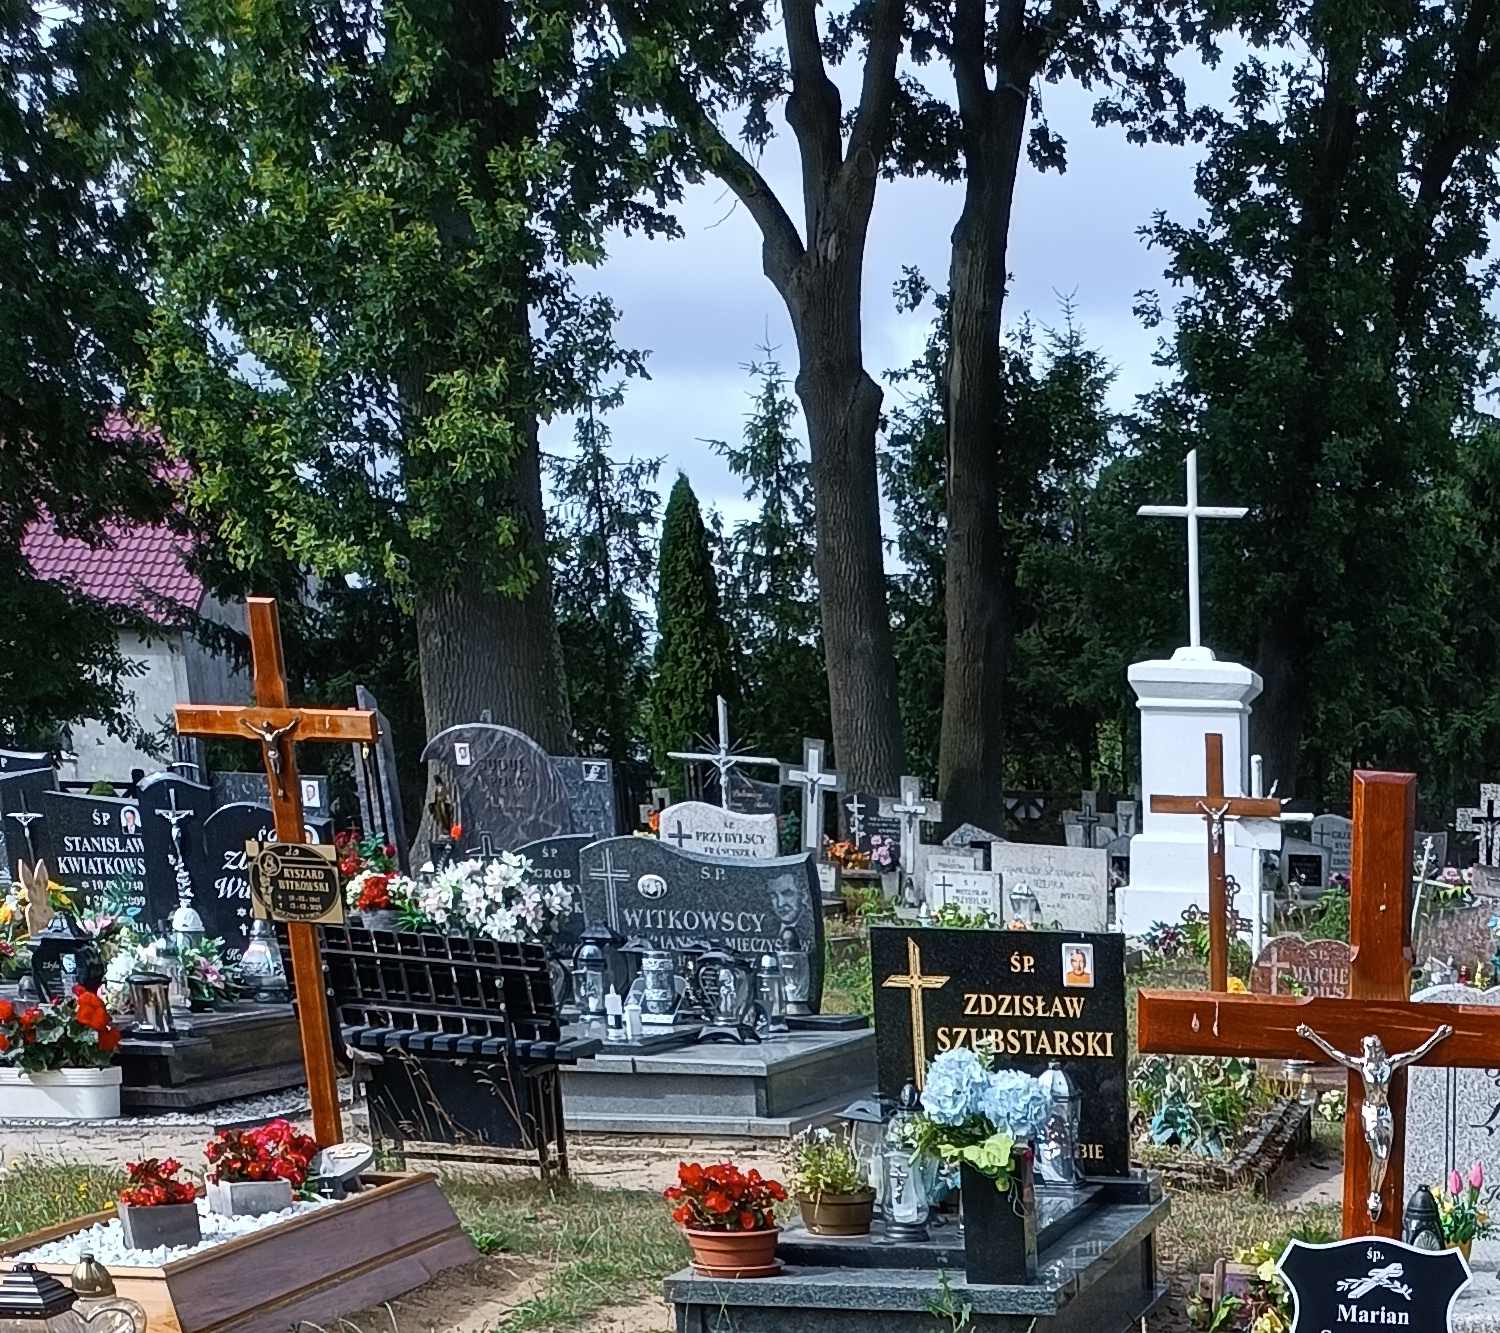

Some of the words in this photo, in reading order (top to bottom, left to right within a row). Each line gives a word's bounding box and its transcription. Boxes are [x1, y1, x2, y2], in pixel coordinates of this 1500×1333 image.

[57, 857, 146, 875] KWIATKOWS
[283, 868, 325, 880] RYSZARD
[623, 908, 765, 932] WITKOWSCY
[1292, 965, 1349, 984] MAJCHE
[963, 994, 1085, 1019] ZDZISŁAW
[937, 1027, 1114, 1057] SZUBSTARSKI
[1366, 1247, 1385, 1263] śp.
[1337, 1304, 1410, 1325] Marian
